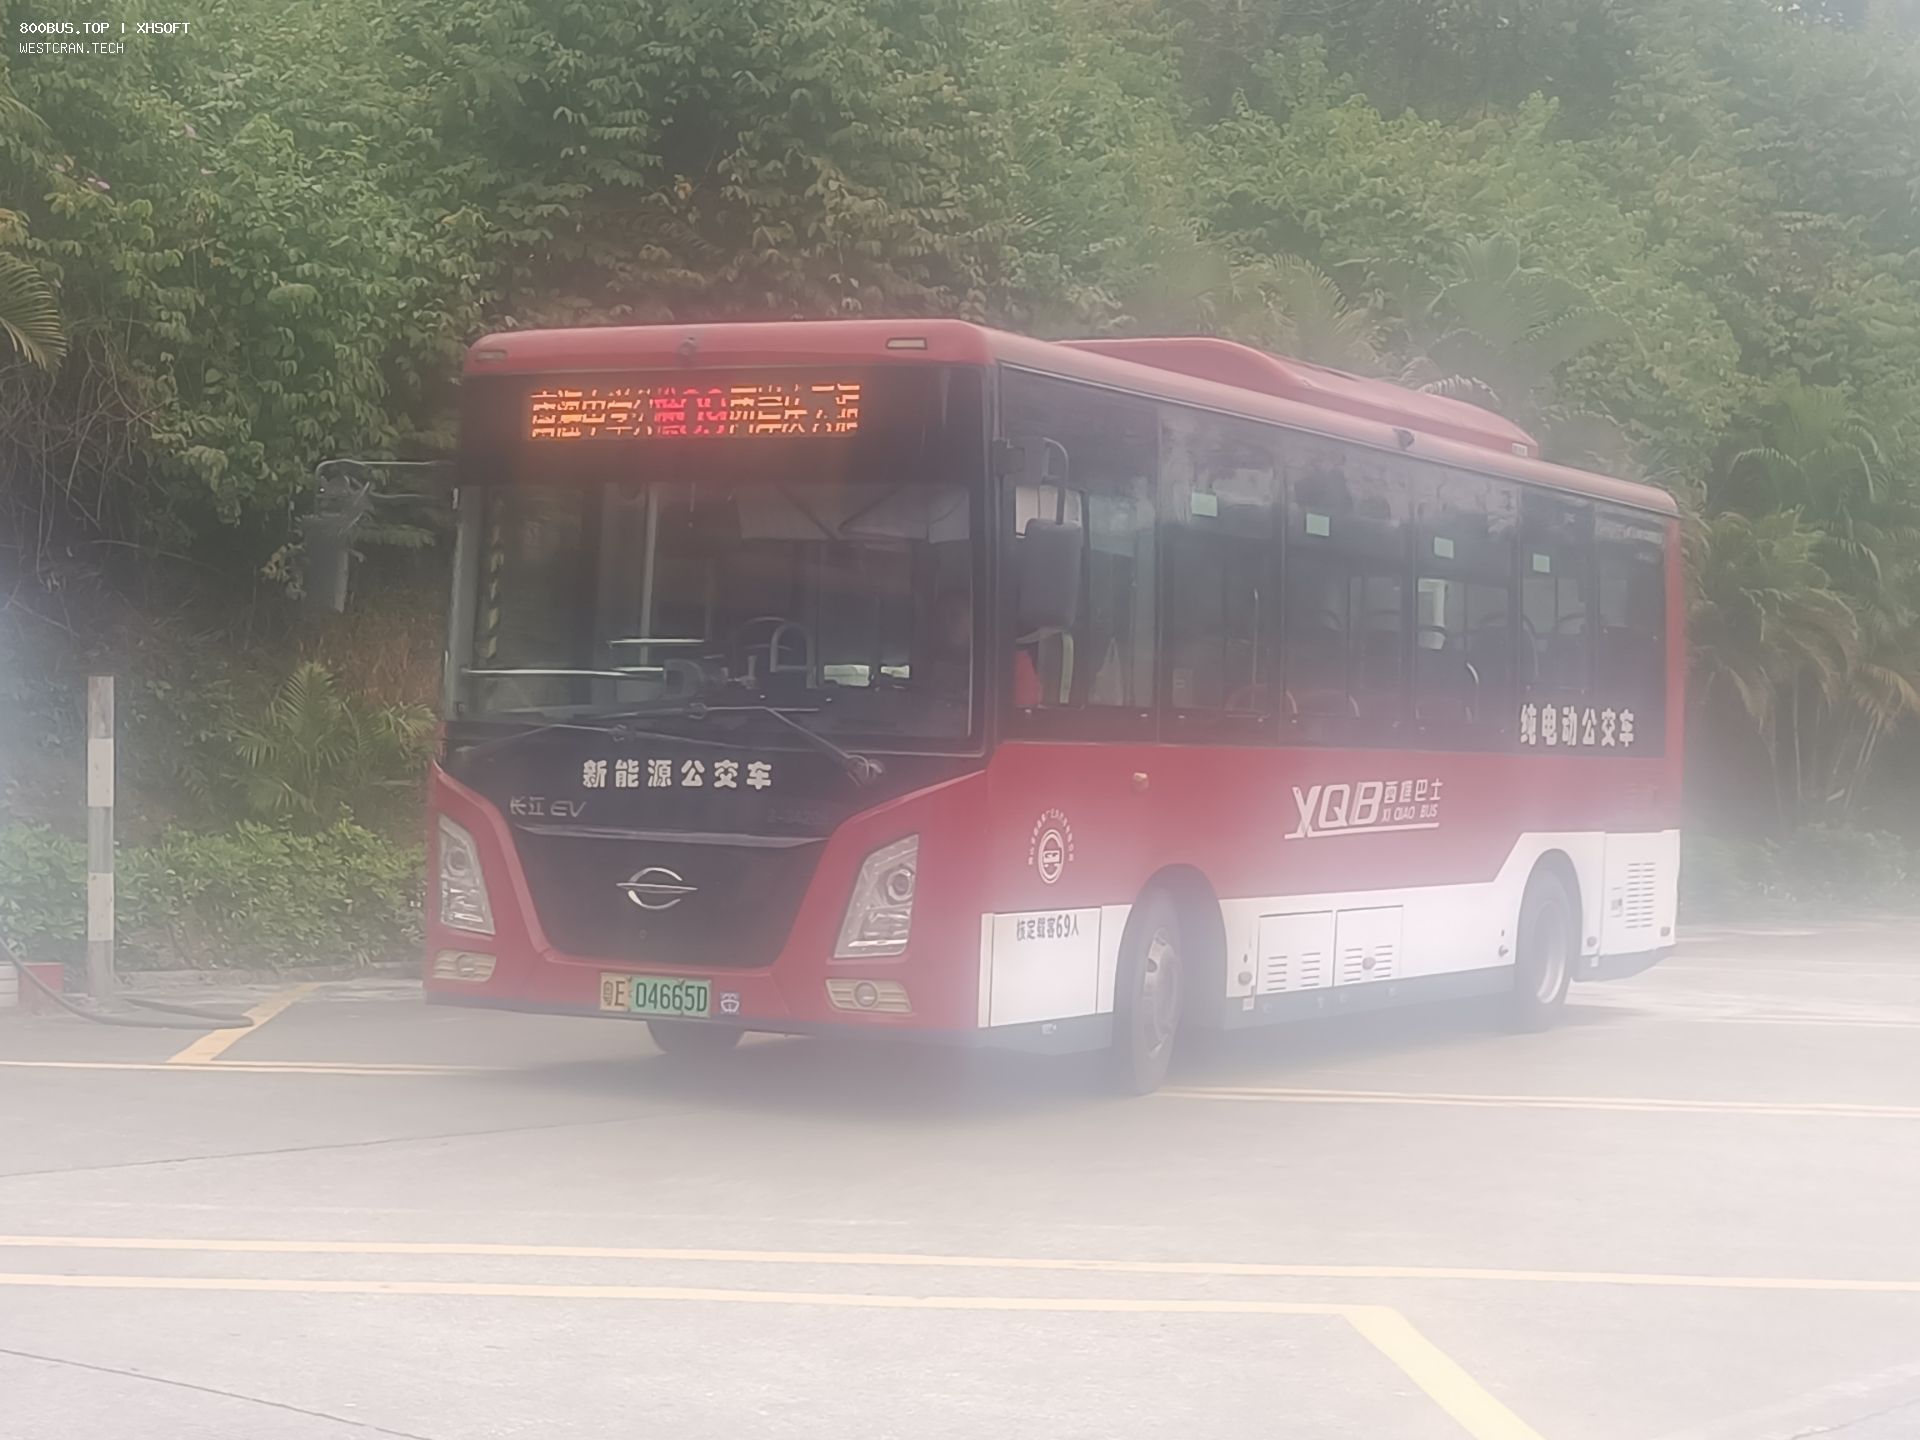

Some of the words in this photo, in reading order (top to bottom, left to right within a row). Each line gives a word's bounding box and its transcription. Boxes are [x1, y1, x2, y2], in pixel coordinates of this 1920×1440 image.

[1520, 703, 1634, 748] 纯电动公交车
[582, 759, 772, 790] 新能源公交车
[510, 796, 545, 816] 长江
[550, 800, 587, 818] EV
[1419, 804, 1439, 819] BUS
